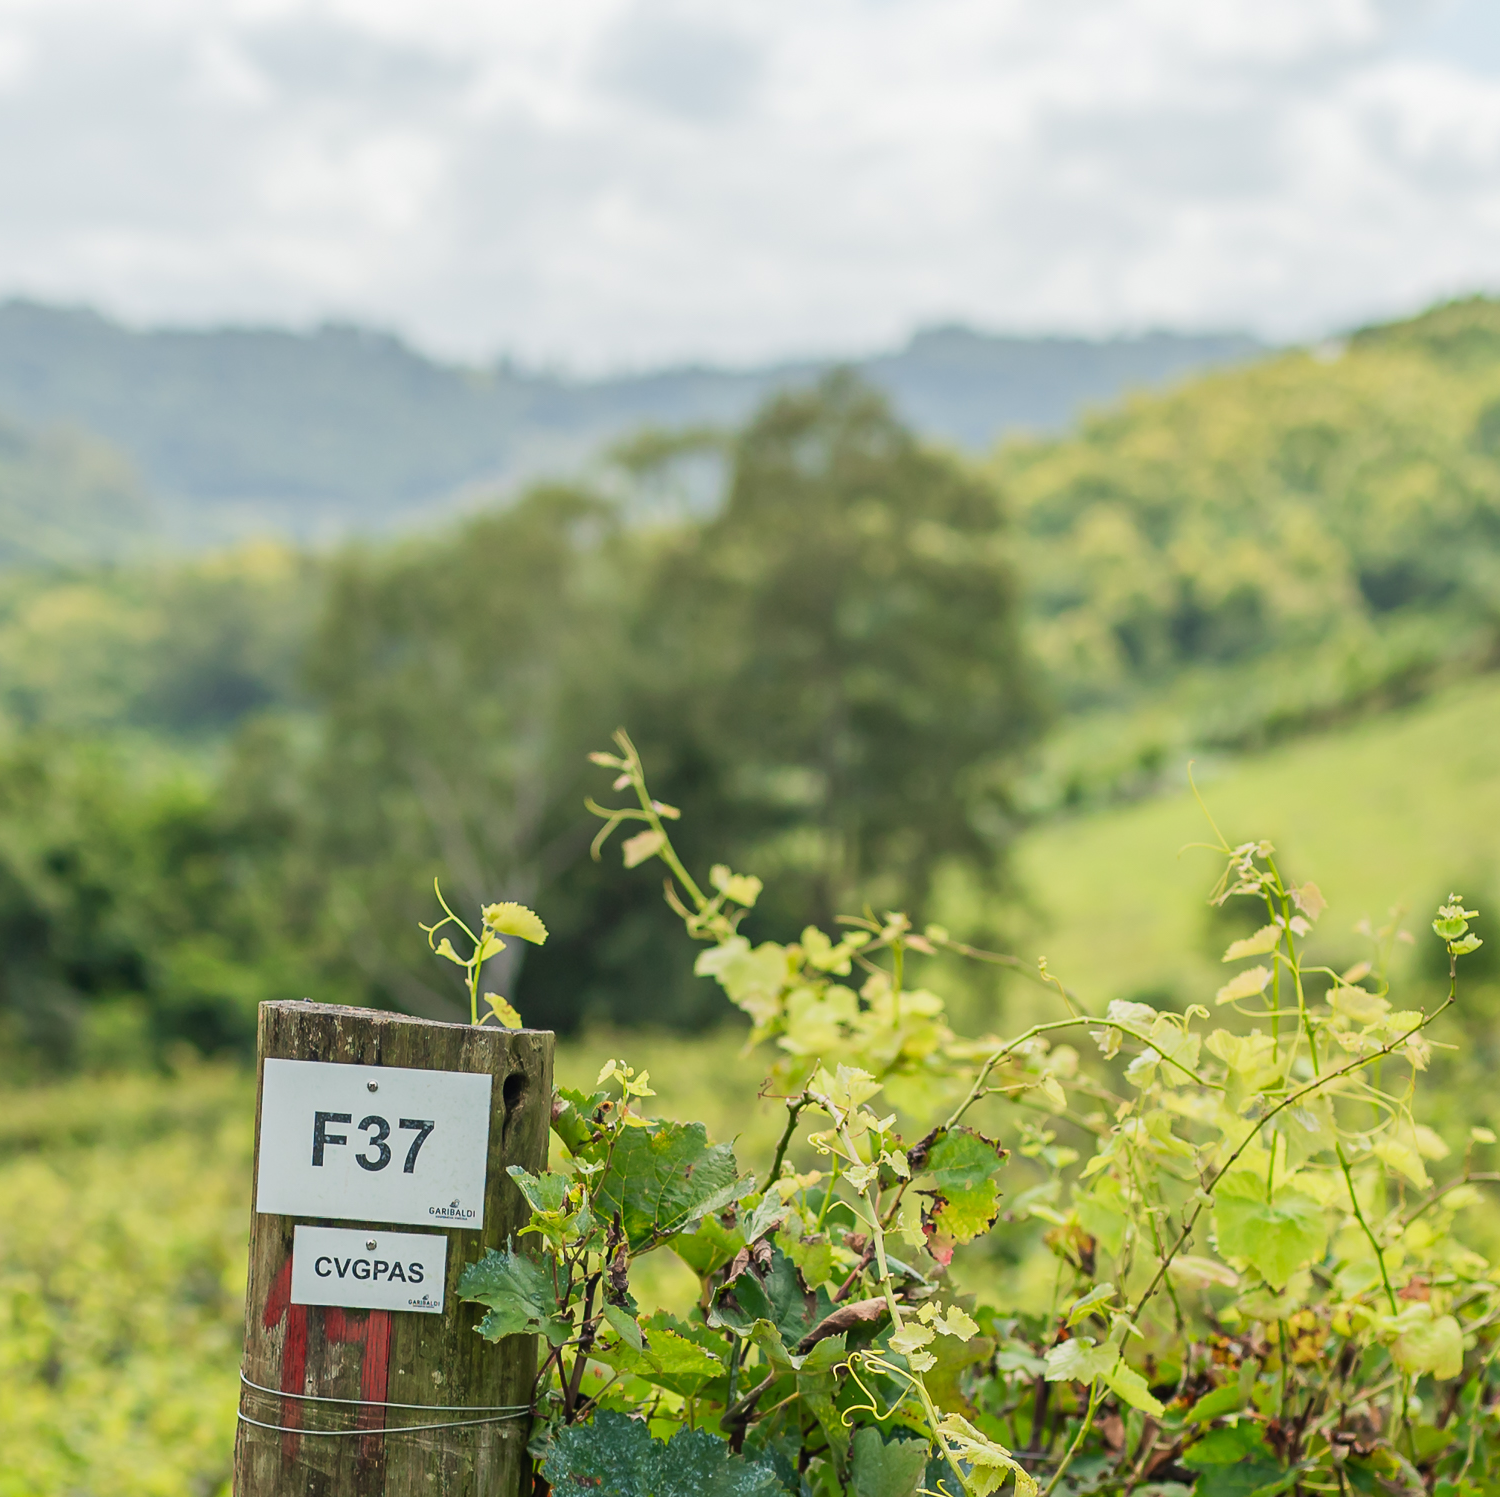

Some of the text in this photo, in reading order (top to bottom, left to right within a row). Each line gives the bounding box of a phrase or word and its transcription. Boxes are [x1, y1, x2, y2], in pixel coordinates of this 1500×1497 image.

[312, 1111, 435, 1174] F37
[428, 1206, 476, 1218] GARIBALDI
[314, 1256, 425, 1283] CVGPAS
